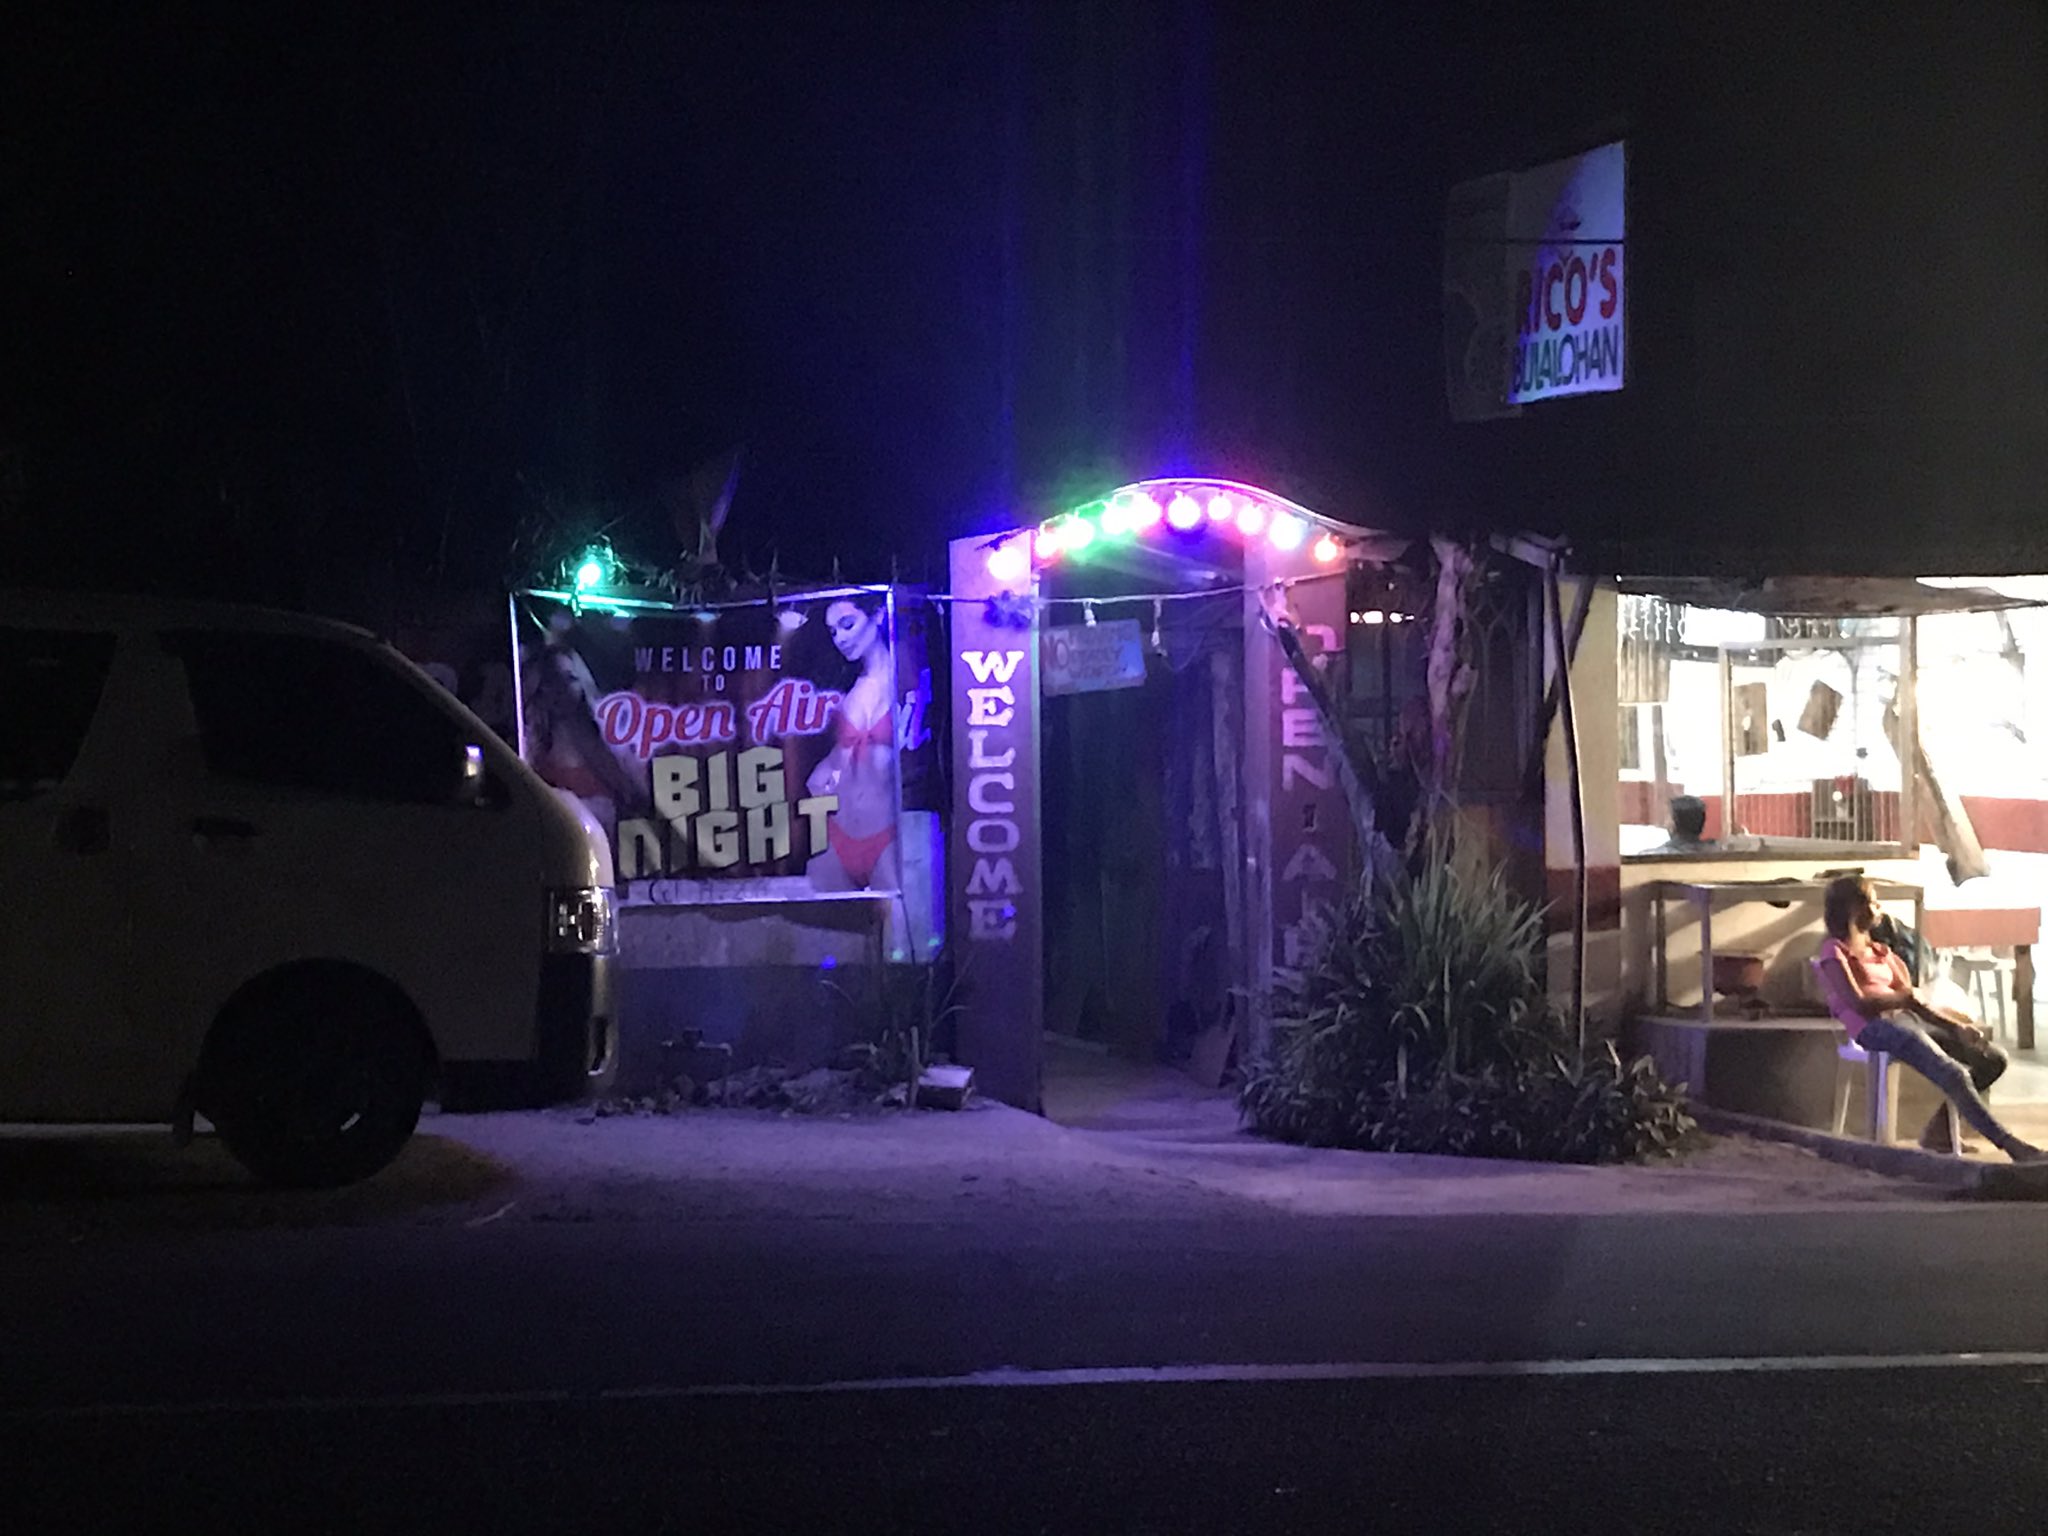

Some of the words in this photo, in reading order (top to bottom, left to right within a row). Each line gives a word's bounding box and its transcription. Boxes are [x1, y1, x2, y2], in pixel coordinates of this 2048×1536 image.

[1516, 248, 1618, 337] RICO'S
[634, 643, 783, 673] WELCOME
[701, 674, 726, 693] TO
[597, 692, 734, 759] Open
[749, 681, 841, 741] Air
[652, 746, 787, 820] BIG
[960, 650, 1025, 941] WELCOME
[617, 795, 840, 878] NIGHT
